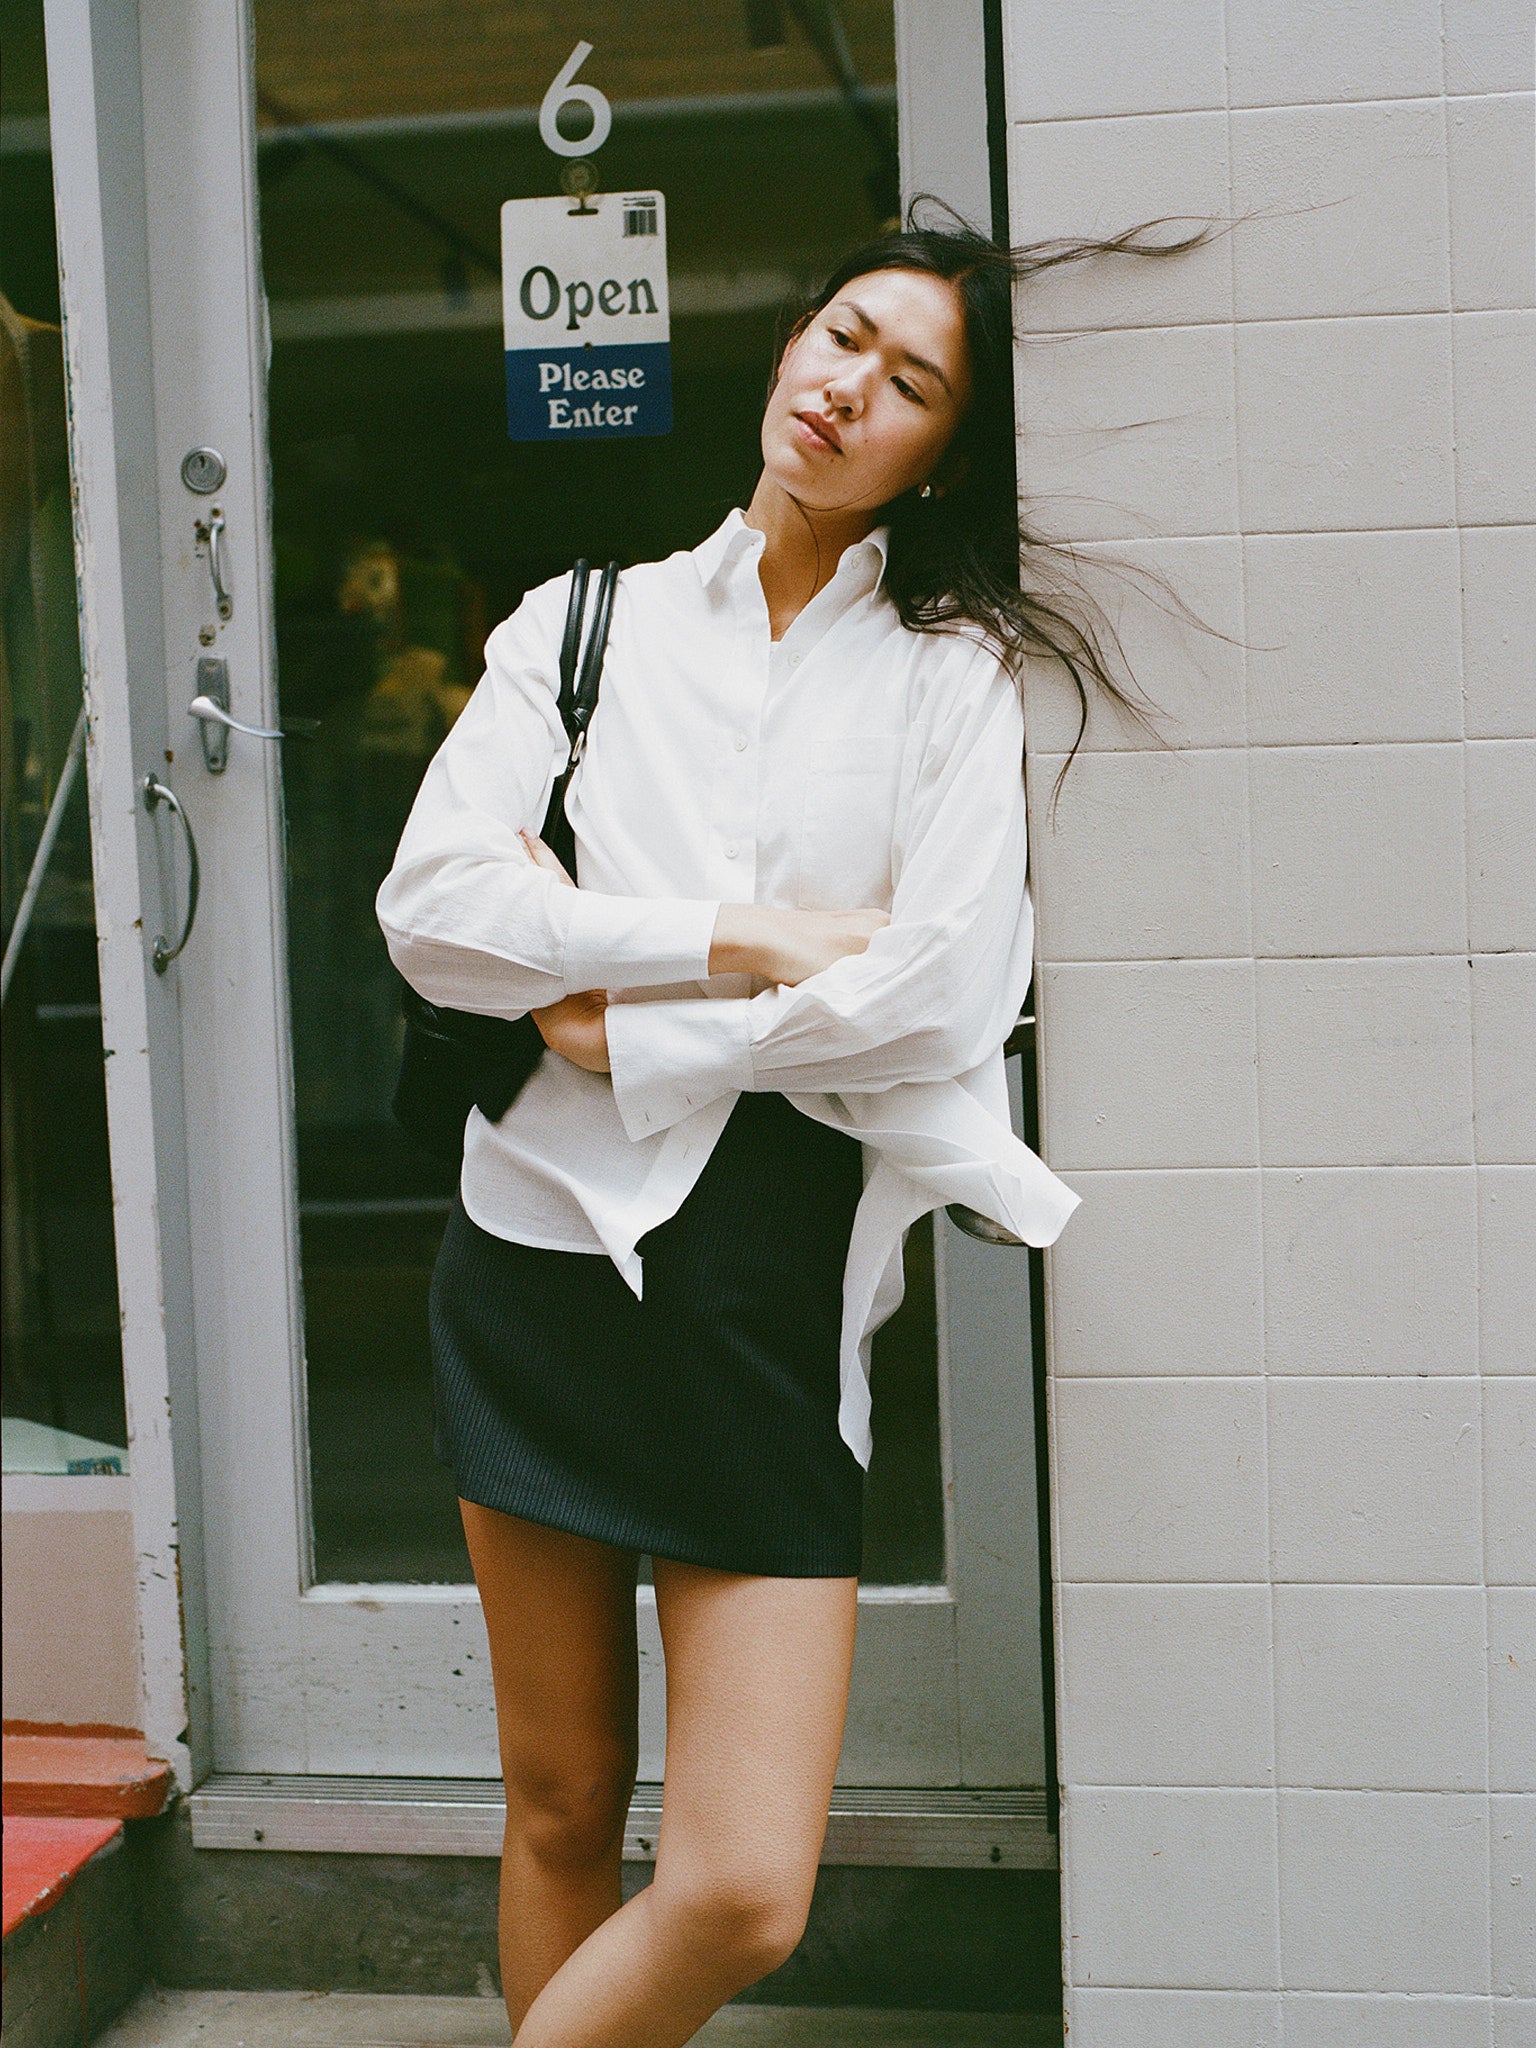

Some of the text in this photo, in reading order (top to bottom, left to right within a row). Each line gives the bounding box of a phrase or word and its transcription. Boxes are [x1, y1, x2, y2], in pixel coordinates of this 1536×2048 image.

[538, 40, 612, 157] 6
[519, 265, 660, 331] Open
[538, 362, 646, 393] Please
[547, 398, 639, 430] Enter
